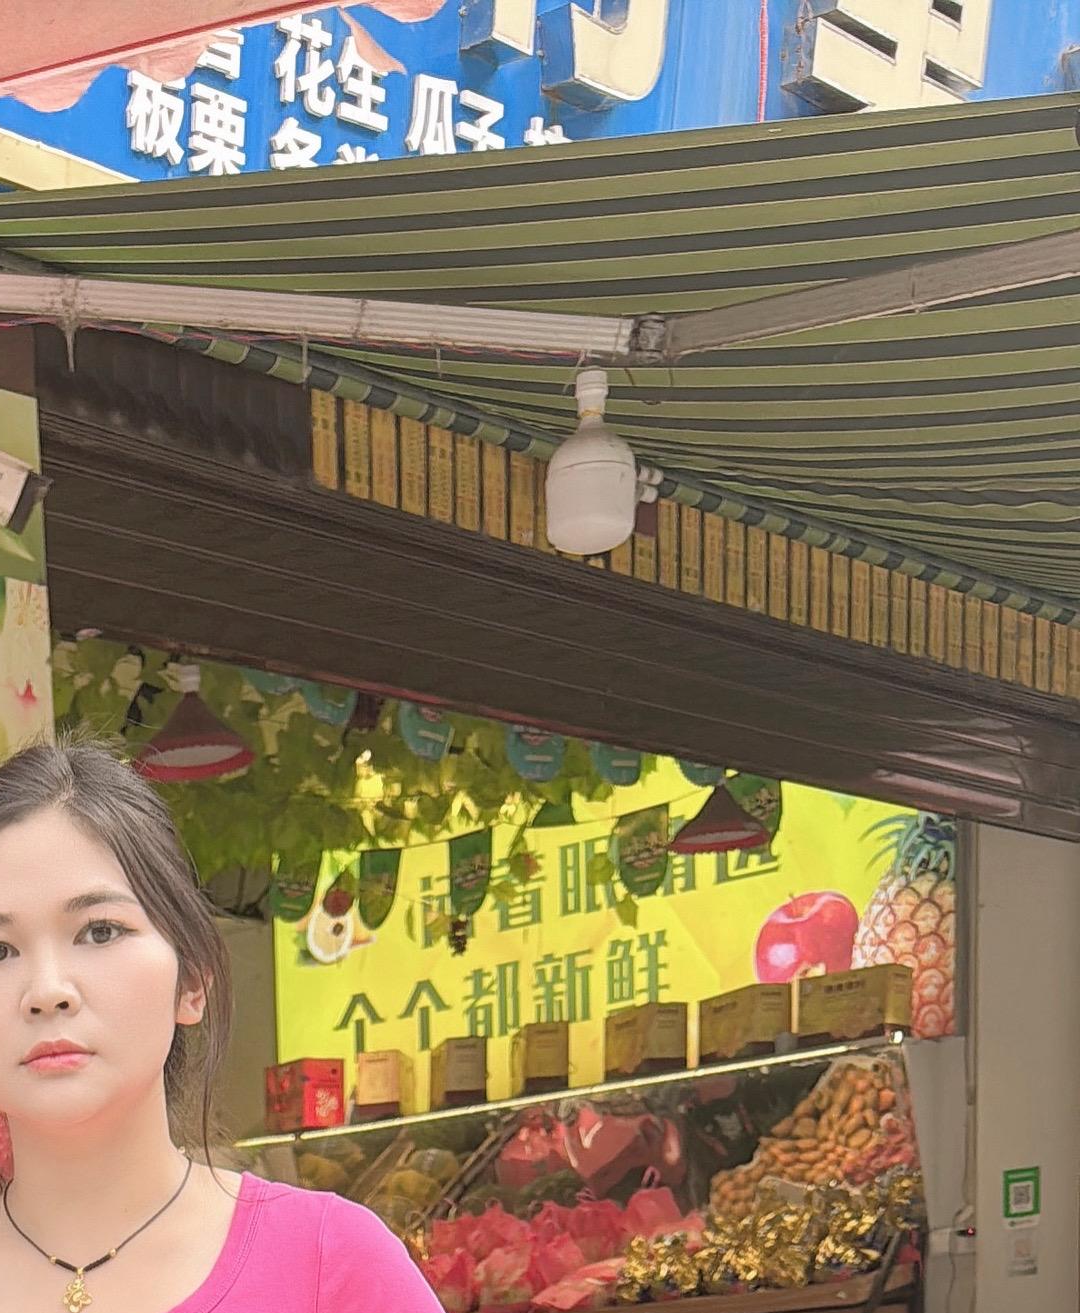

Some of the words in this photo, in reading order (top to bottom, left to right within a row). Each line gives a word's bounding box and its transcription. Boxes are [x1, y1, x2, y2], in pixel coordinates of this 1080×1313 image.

[334, 929, 670, 1054] 个个都新鲜
